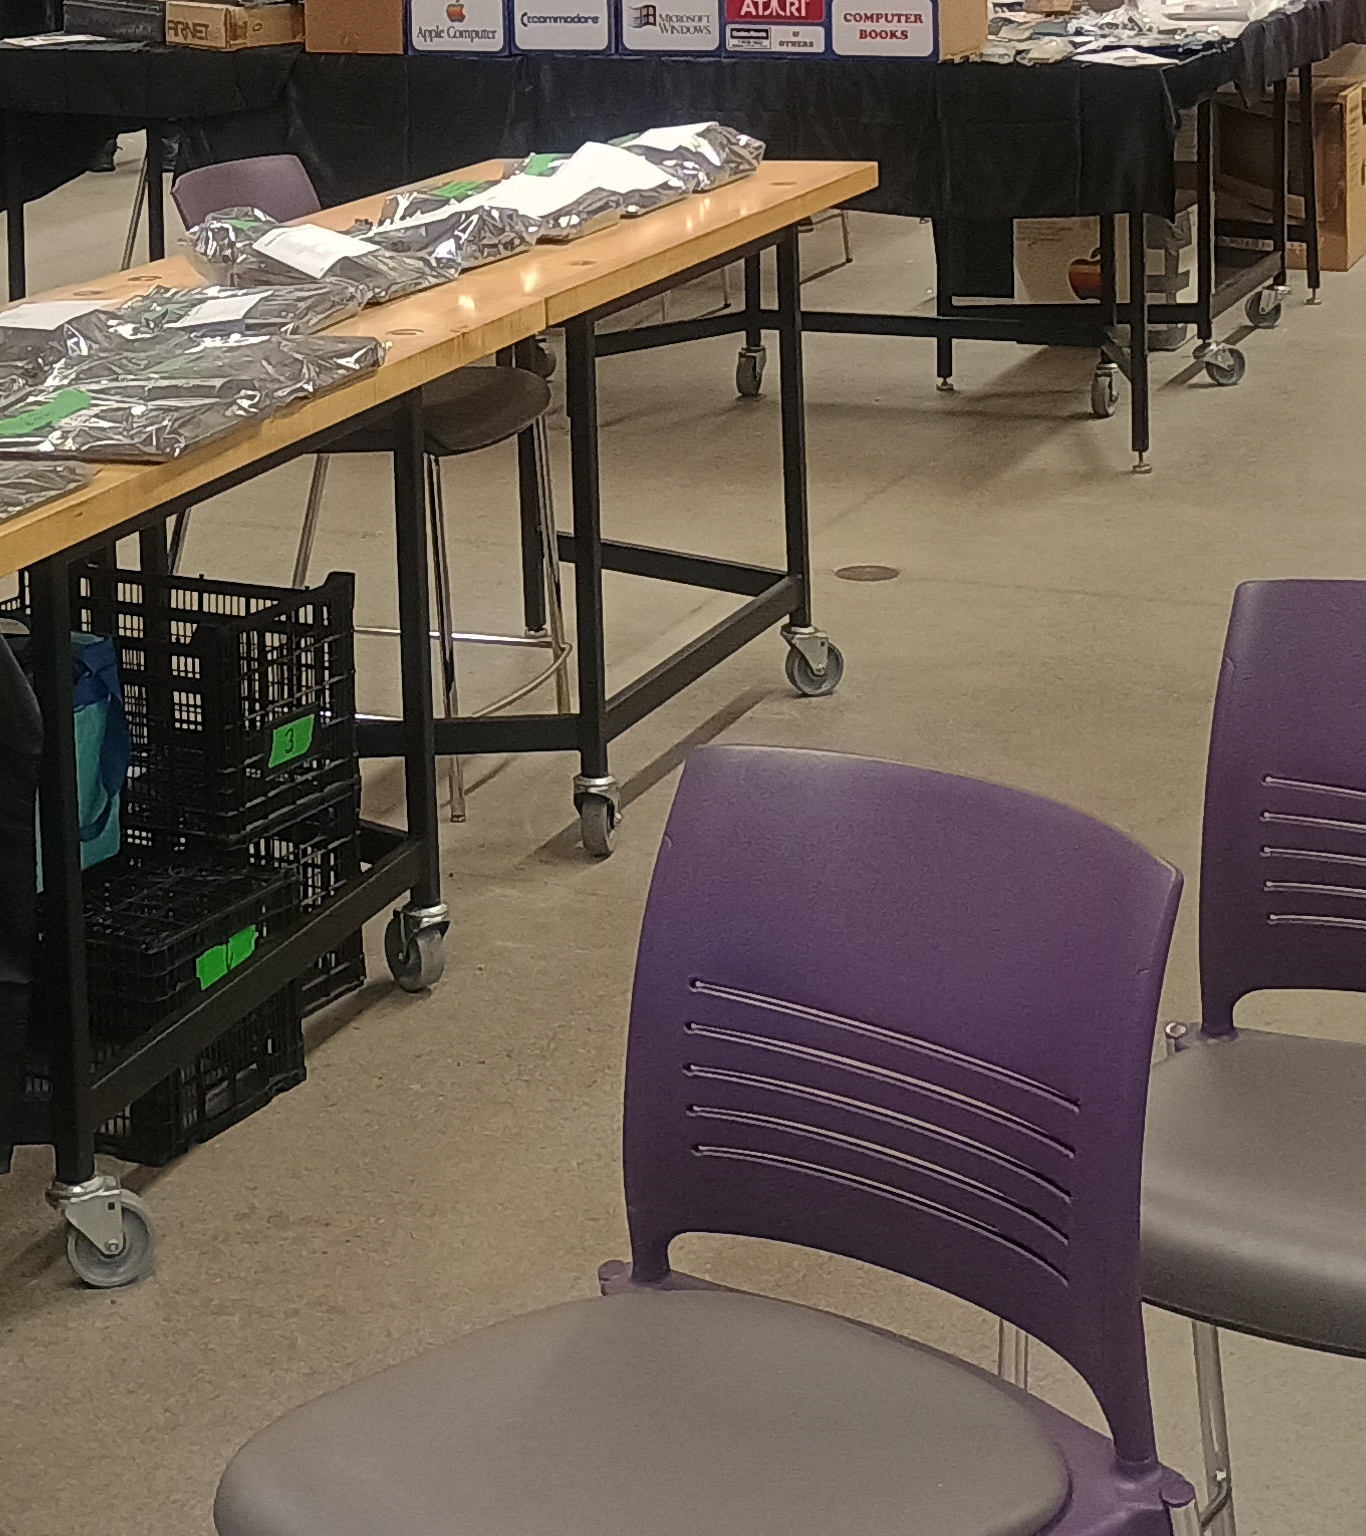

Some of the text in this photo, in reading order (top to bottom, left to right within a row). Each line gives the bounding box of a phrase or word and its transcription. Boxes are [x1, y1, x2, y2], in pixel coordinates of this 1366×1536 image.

[658, 13, 711, 25] MICROSOFT
[843, 13, 924, 25] COMPUTER
[416, 25, 498, 43] Apple Computer
[658, 23, 712, 36] WINDOWS
[858, 29, 909, 41] BOOKS
[284, 727, 294, 754] 3
